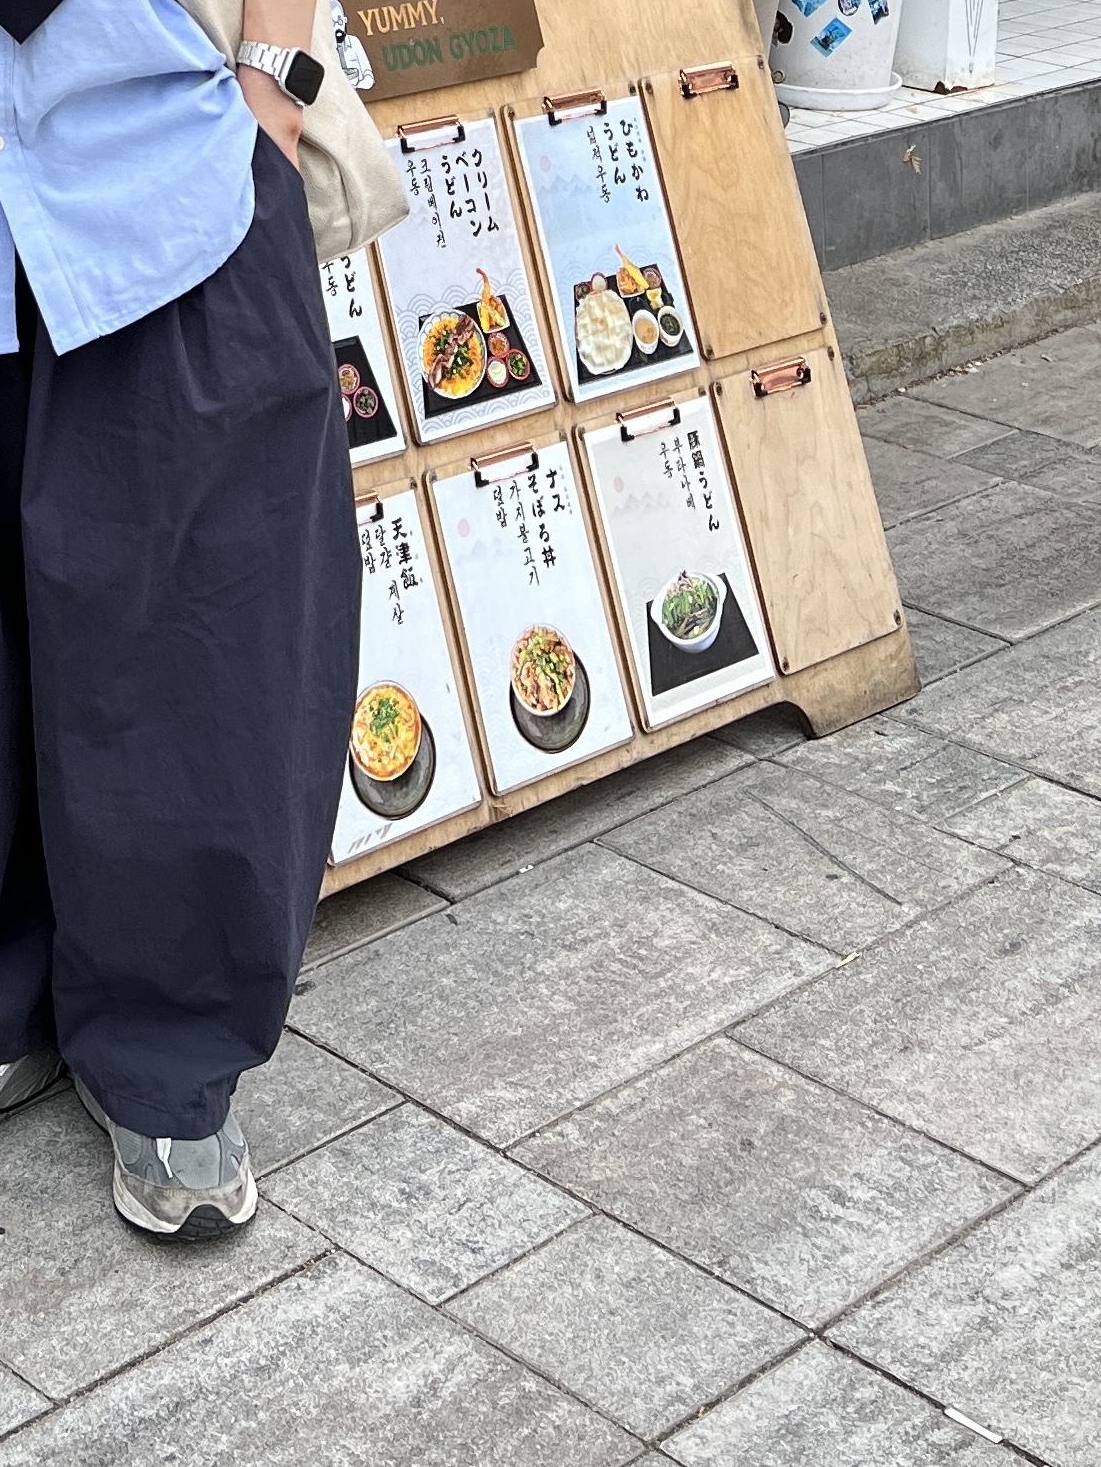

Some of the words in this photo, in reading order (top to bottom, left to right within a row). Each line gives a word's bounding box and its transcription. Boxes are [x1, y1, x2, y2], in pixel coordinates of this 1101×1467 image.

[381, 36, 444, 72] UDON
[448, 24, 517, 60] GYOZA
[405, 159, 421, 196] 우동
[603, 122, 626, 185] うどん
[619, 119, 649, 202] ひもかわ
[441, 155, 463, 219] うどん
[455, 151, 482, 237] ベーコン
[472, 148, 500, 233] クリーム
[546, 468, 566, 512] ナス
[659, 441, 674, 479] 우동
[493, 485, 508, 529] 덮밥
[509, 479, 540, 586] 가지불고기
[527, 473, 557, 569] そぼろ丼
[361, 529, 377, 575] 덮밥
[391, 517, 419, 591] 天津飯
